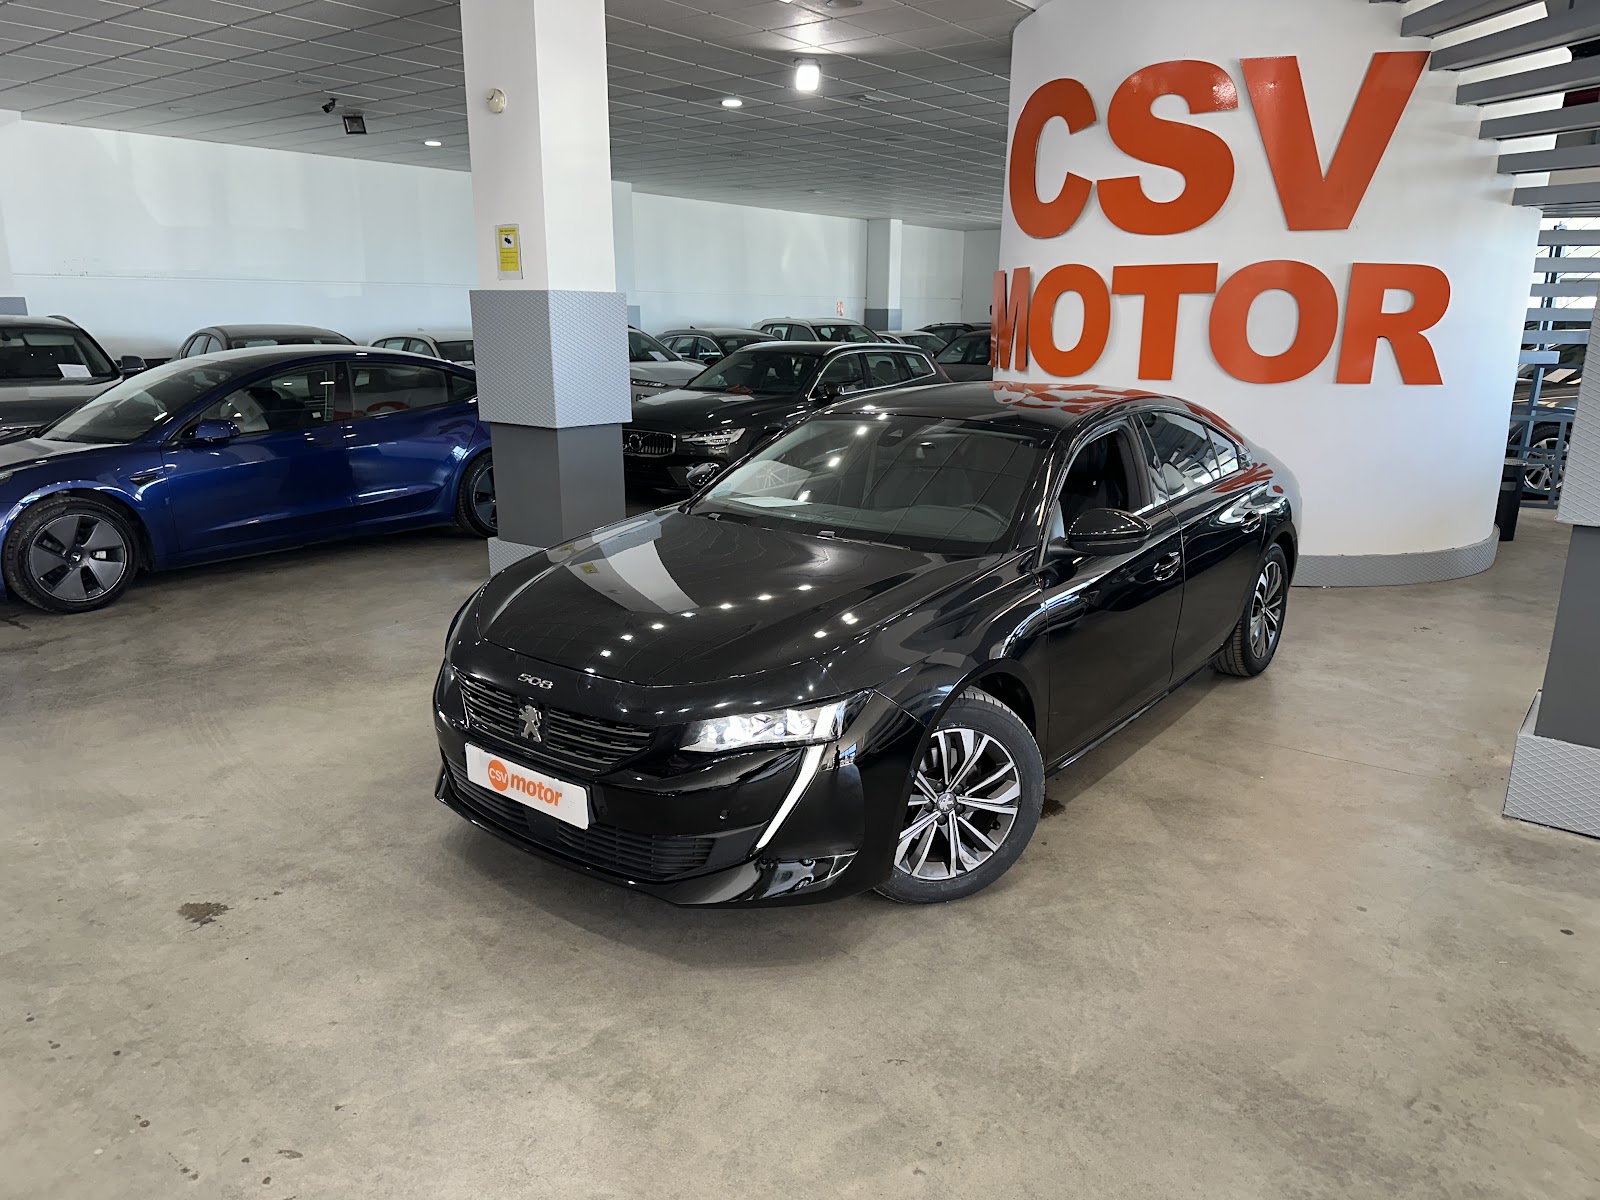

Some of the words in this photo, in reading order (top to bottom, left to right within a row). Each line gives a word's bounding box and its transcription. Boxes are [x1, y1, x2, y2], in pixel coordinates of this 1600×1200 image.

[1008, 51, 1431, 239] CSV
[990, 259, 1451, 386] MOTOR
[517, 673, 554, 690] 508
[488, 767, 508, 784] CSV
[510, 773, 563, 807] motor
